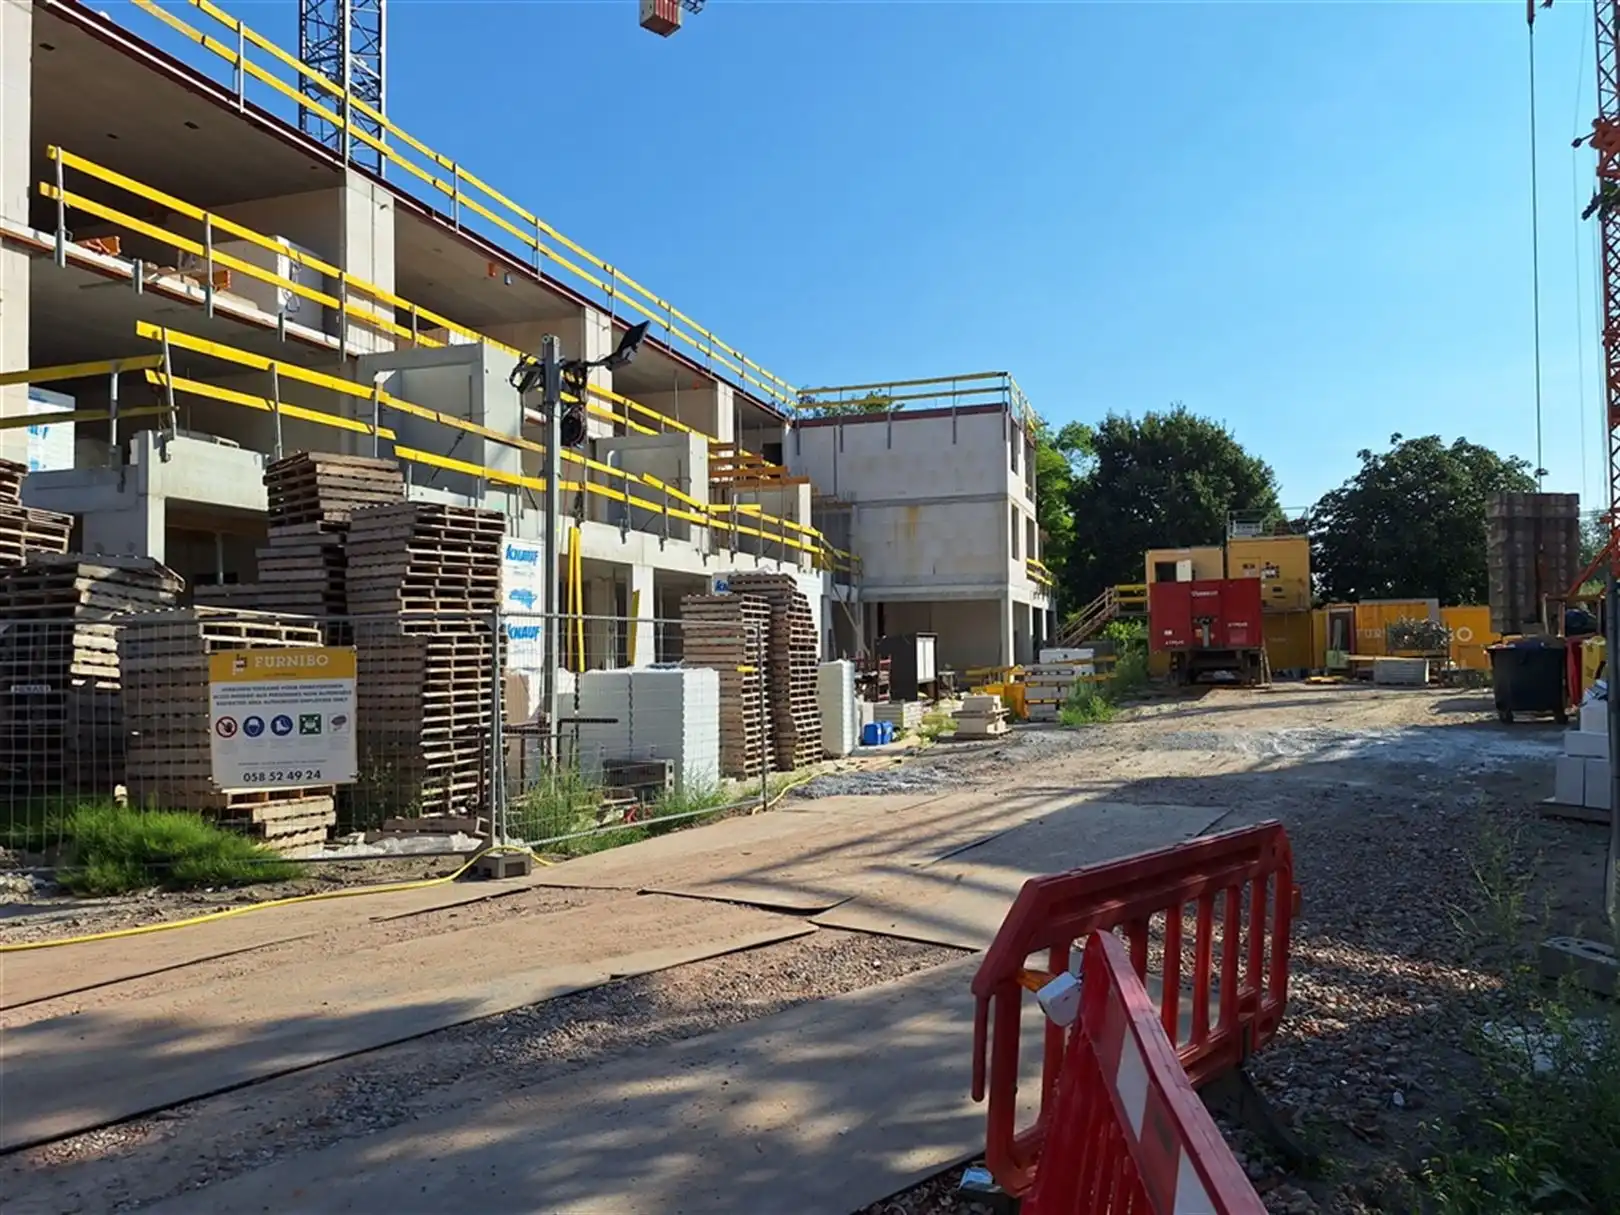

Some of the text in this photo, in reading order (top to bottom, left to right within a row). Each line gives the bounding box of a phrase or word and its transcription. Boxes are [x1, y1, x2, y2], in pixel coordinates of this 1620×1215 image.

[506, 544, 538, 566] KNAUF
[507, 623, 541, 641] KNAUF
[255, 654, 329, 668] FURNIBO
[243, 769, 321, 782] 058 52 49 24
